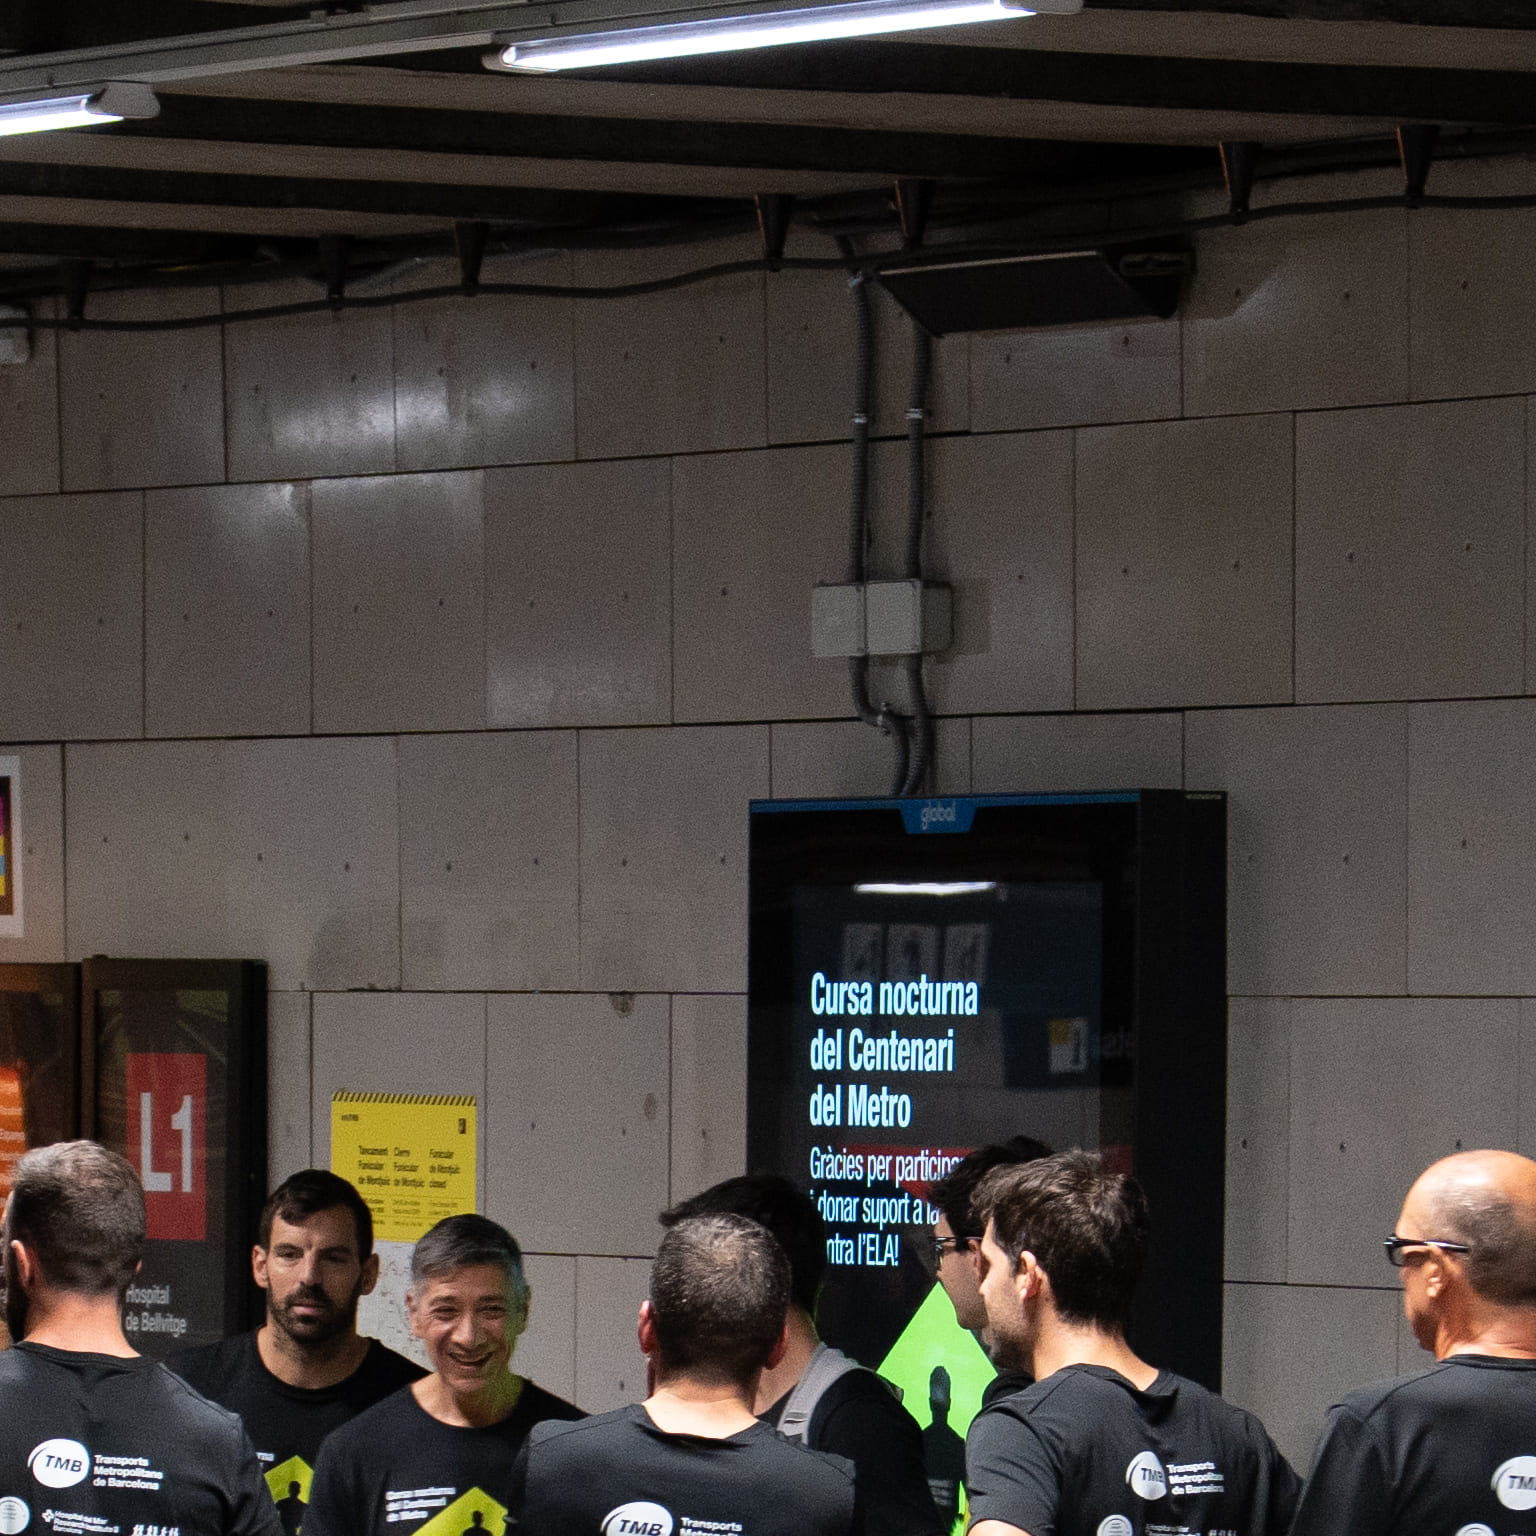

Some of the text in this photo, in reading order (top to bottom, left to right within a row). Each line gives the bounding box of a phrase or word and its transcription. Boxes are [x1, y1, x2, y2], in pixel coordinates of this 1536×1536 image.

[811, 972, 979, 1015] Cursa nocturna
[810, 1027, 954, 1072] del Centenari
[809, 1083, 912, 1128] del Metro
[140, 1091, 193, 1193] L1
[810, 1145, 864, 1180] Gràcies
[867, 1154, 893, 1188] per
[862, 1192, 910, 1231] suport
[913, 1198, 923, 1225] a
[826, 1233, 855, 1265] ntra
[126, 1311, 139, 1332] de
[45, 1455, 83, 1473] TMB
[619, 1519, 663, 1536] TMB
[680, 1517, 742, 1532] Transports
